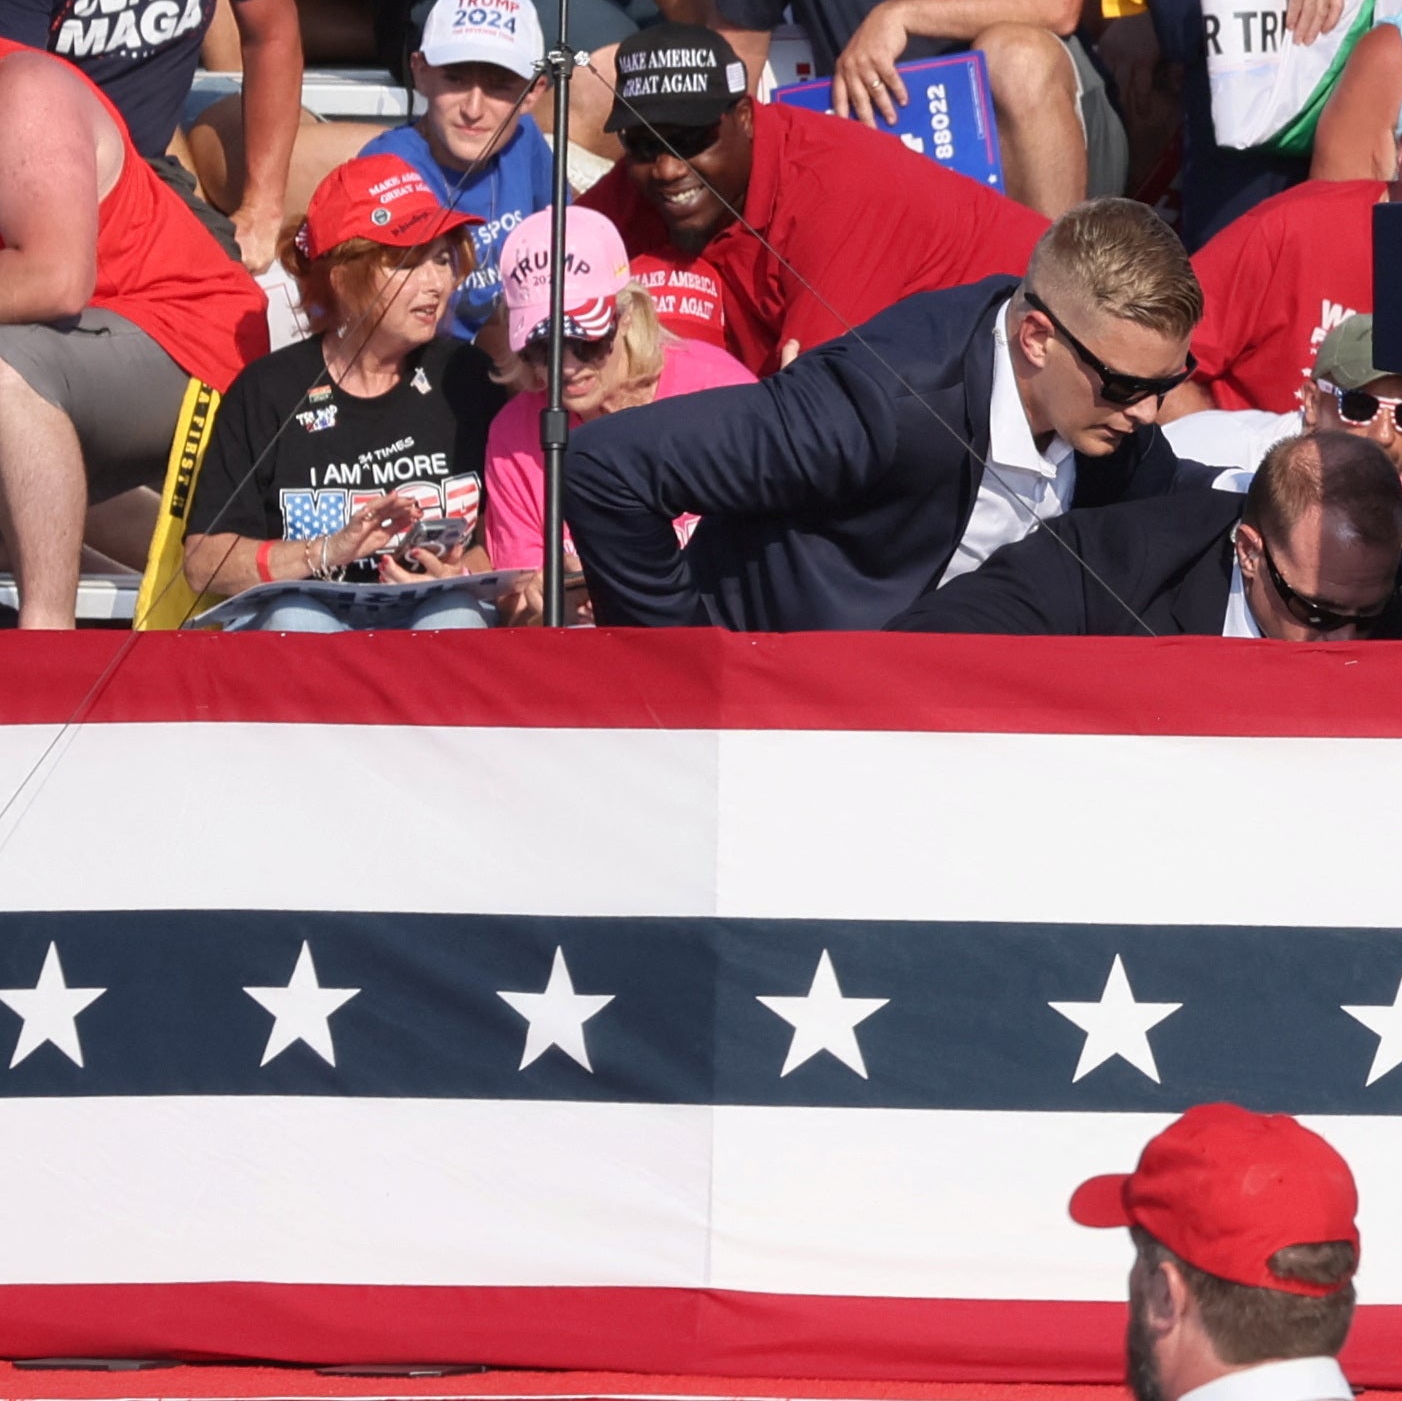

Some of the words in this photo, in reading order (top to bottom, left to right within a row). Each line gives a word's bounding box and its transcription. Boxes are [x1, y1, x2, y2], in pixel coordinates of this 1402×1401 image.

[453, 8, 517, 34] 2024
[620, 52, 648, 73] MAKE
[648, 48, 718, 71] AMERICA
[622, 75, 661, 98] GREAT
[661, 73, 710, 93] AGAIN
[933, 83, 954, 160] 88022
[369, 175, 401, 197] MAKE
[380, 185, 415, 205] GREAT
[668, 270, 718, 298] AMERICA
[176, 414, 209, 488] FIRST
[373, 436, 416, 462] TIMES
[310, 467, 317, 487] I
[319, 461, 362, 487] AM
[372, 452, 450, 485] MORE
